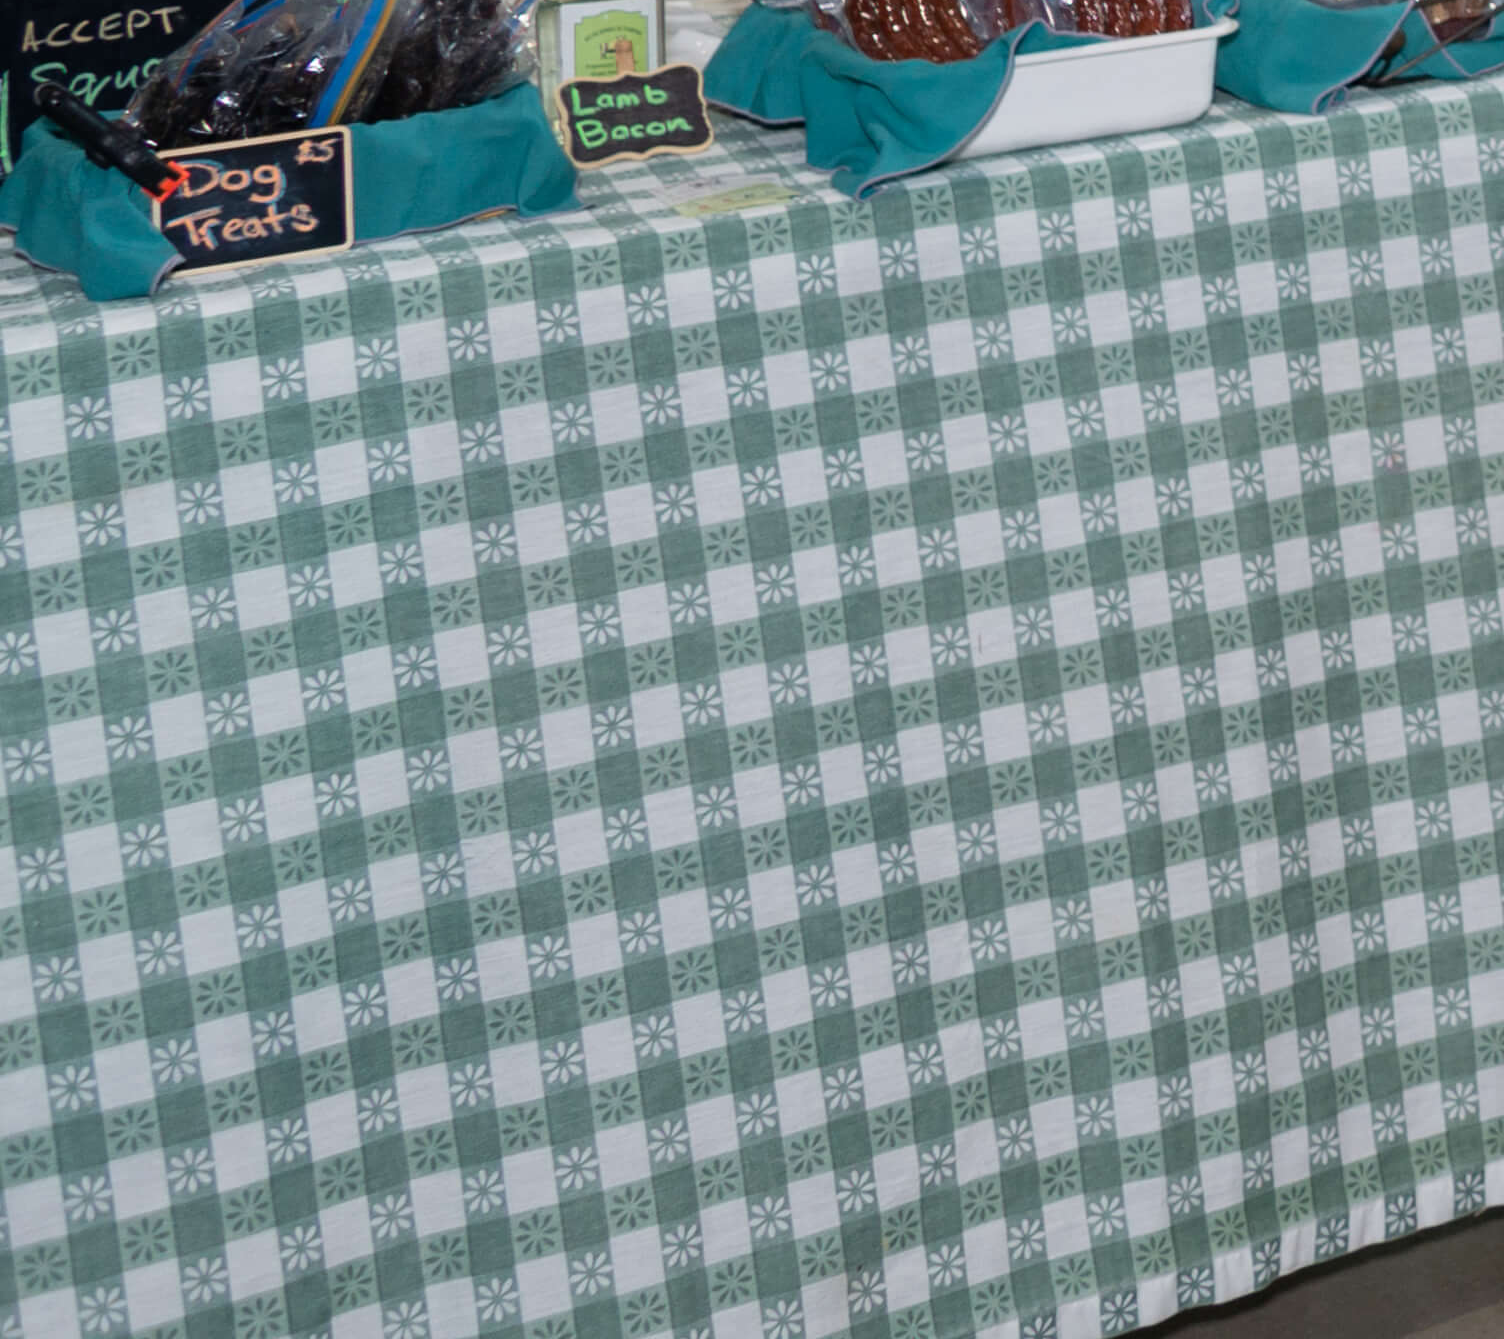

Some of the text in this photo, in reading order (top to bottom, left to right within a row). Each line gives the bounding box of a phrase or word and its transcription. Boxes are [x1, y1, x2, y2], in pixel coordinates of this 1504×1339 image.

[21, 5, 183, 53] ACCEPT
[569, 83, 669, 117] Lamb
[575, 116, 694, 149] Bacon
[174, 158, 288, 204] Dog
[165, 203, 320, 251] Treats
